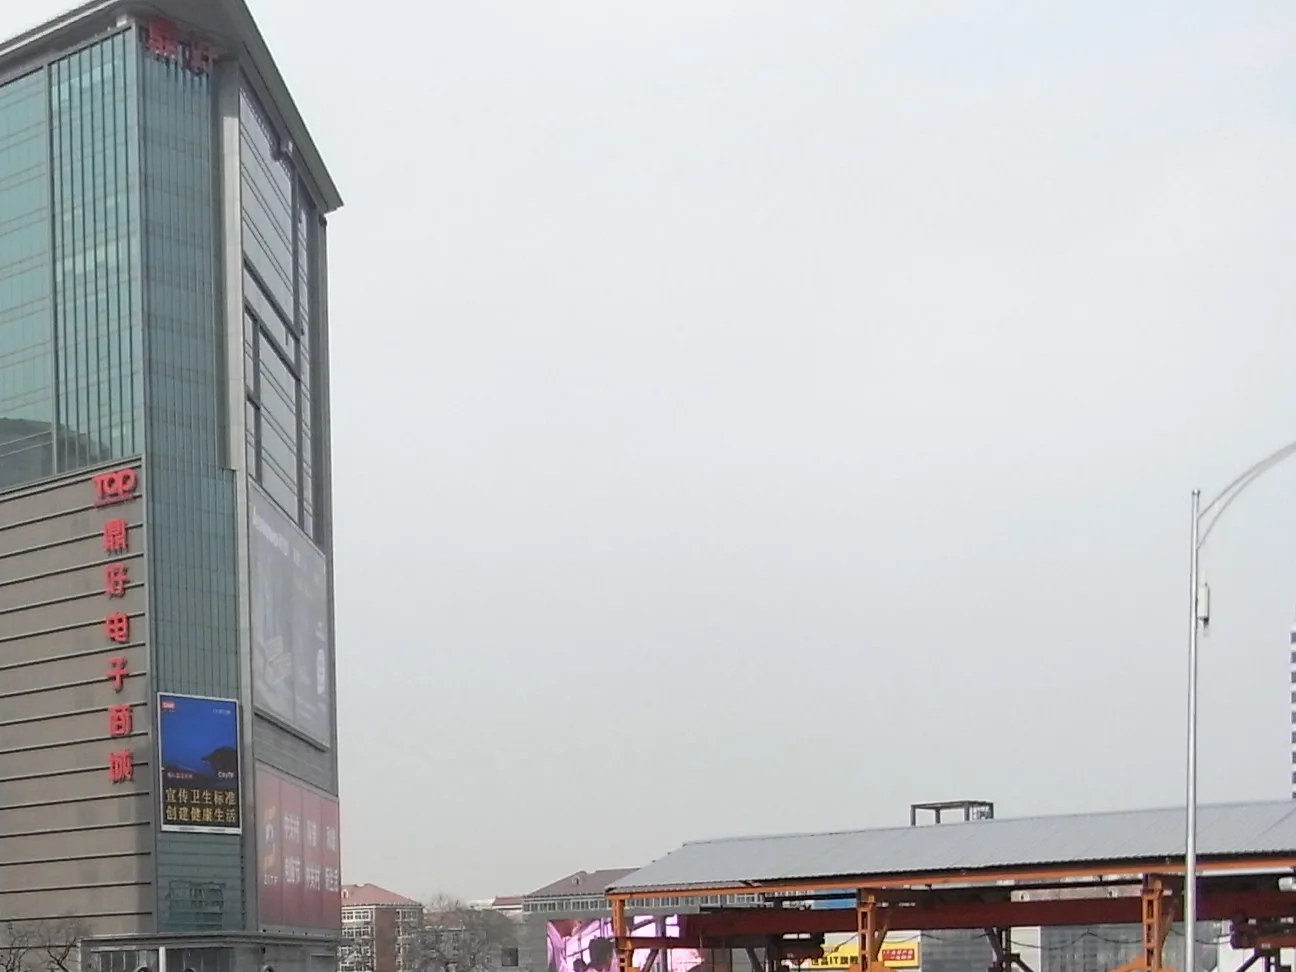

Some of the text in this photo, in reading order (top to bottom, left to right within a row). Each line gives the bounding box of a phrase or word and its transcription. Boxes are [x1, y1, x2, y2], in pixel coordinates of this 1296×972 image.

[92, 468, 136, 500] TOP
[104, 518, 133, 782] 鼎好电子商城
